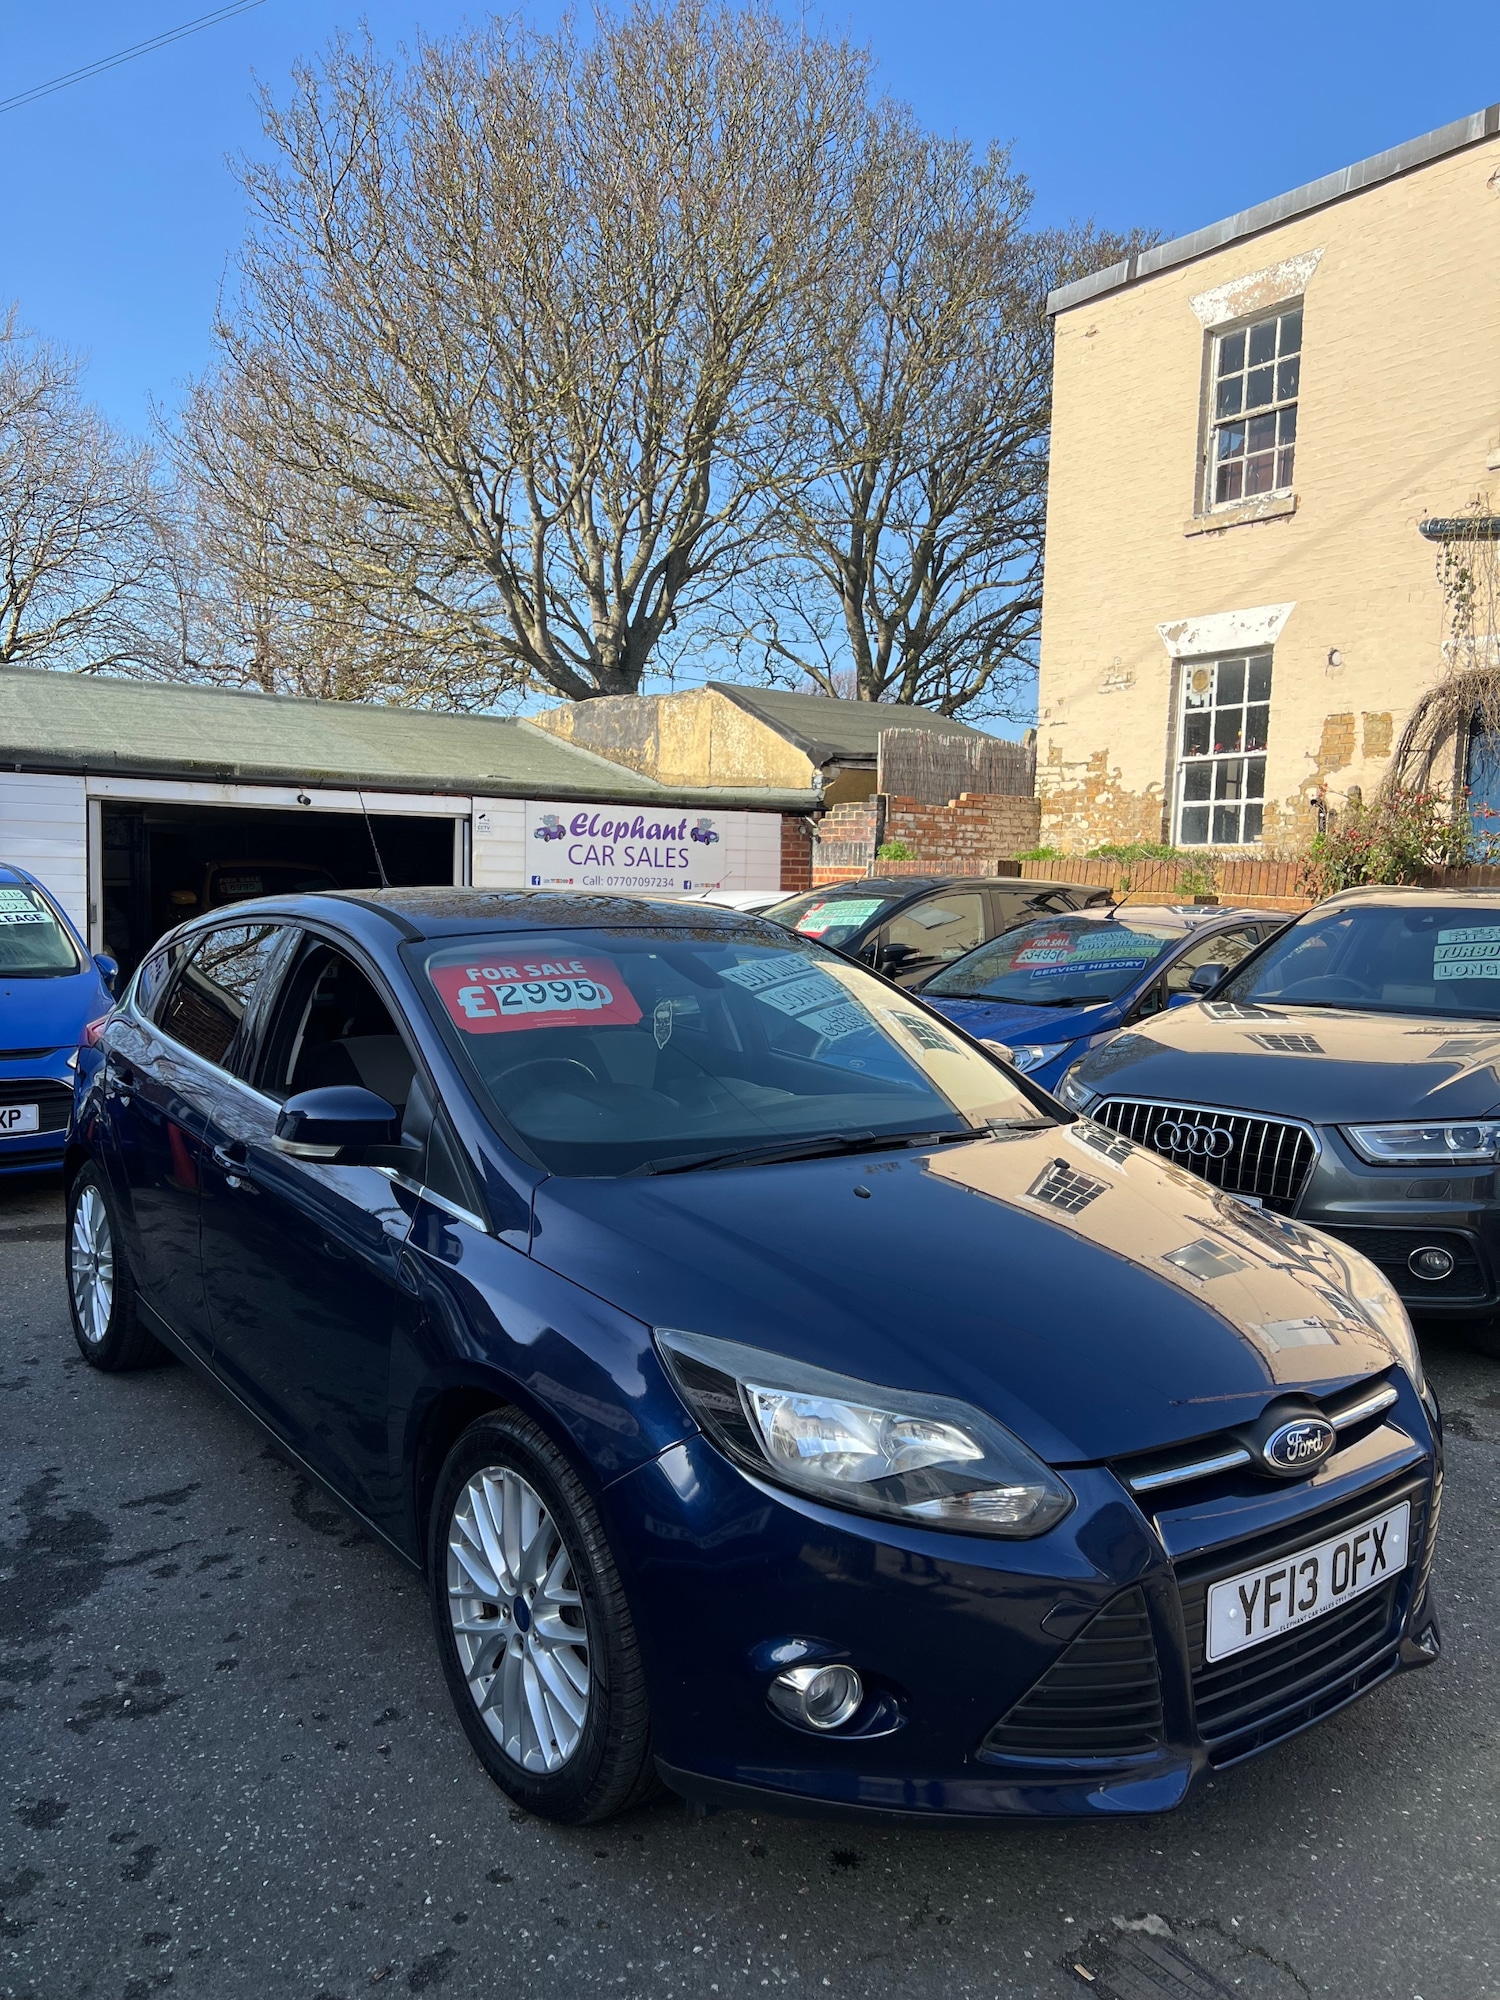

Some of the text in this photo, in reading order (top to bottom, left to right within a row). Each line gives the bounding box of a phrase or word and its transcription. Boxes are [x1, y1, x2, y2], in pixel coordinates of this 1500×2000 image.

[570, 813, 687, 844] Elephant
[568, 844, 690, 868] CAR SALES
[582, 876, 604, 886] Call:
[607, 876, 674, 887] 07707097234
[1439, 945, 1500, 958] TURBO
[465, 961, 587, 982] FOR SALE
[1034, 960, 1142, 976] SERVICE HISTORY
[1440, 963, 1498, 976] LONG
[763, 984, 826, 1010] LONG
[1287, 1427, 1323, 1461] Ford
[1239, 1521, 1388, 1636] YF13 OFX
[1280, 1615, 1307, 1632] ELEPHANT
[1308, 1609, 1319, 1619] CAR
[1320, 1602, 1335, 1613] SALES
